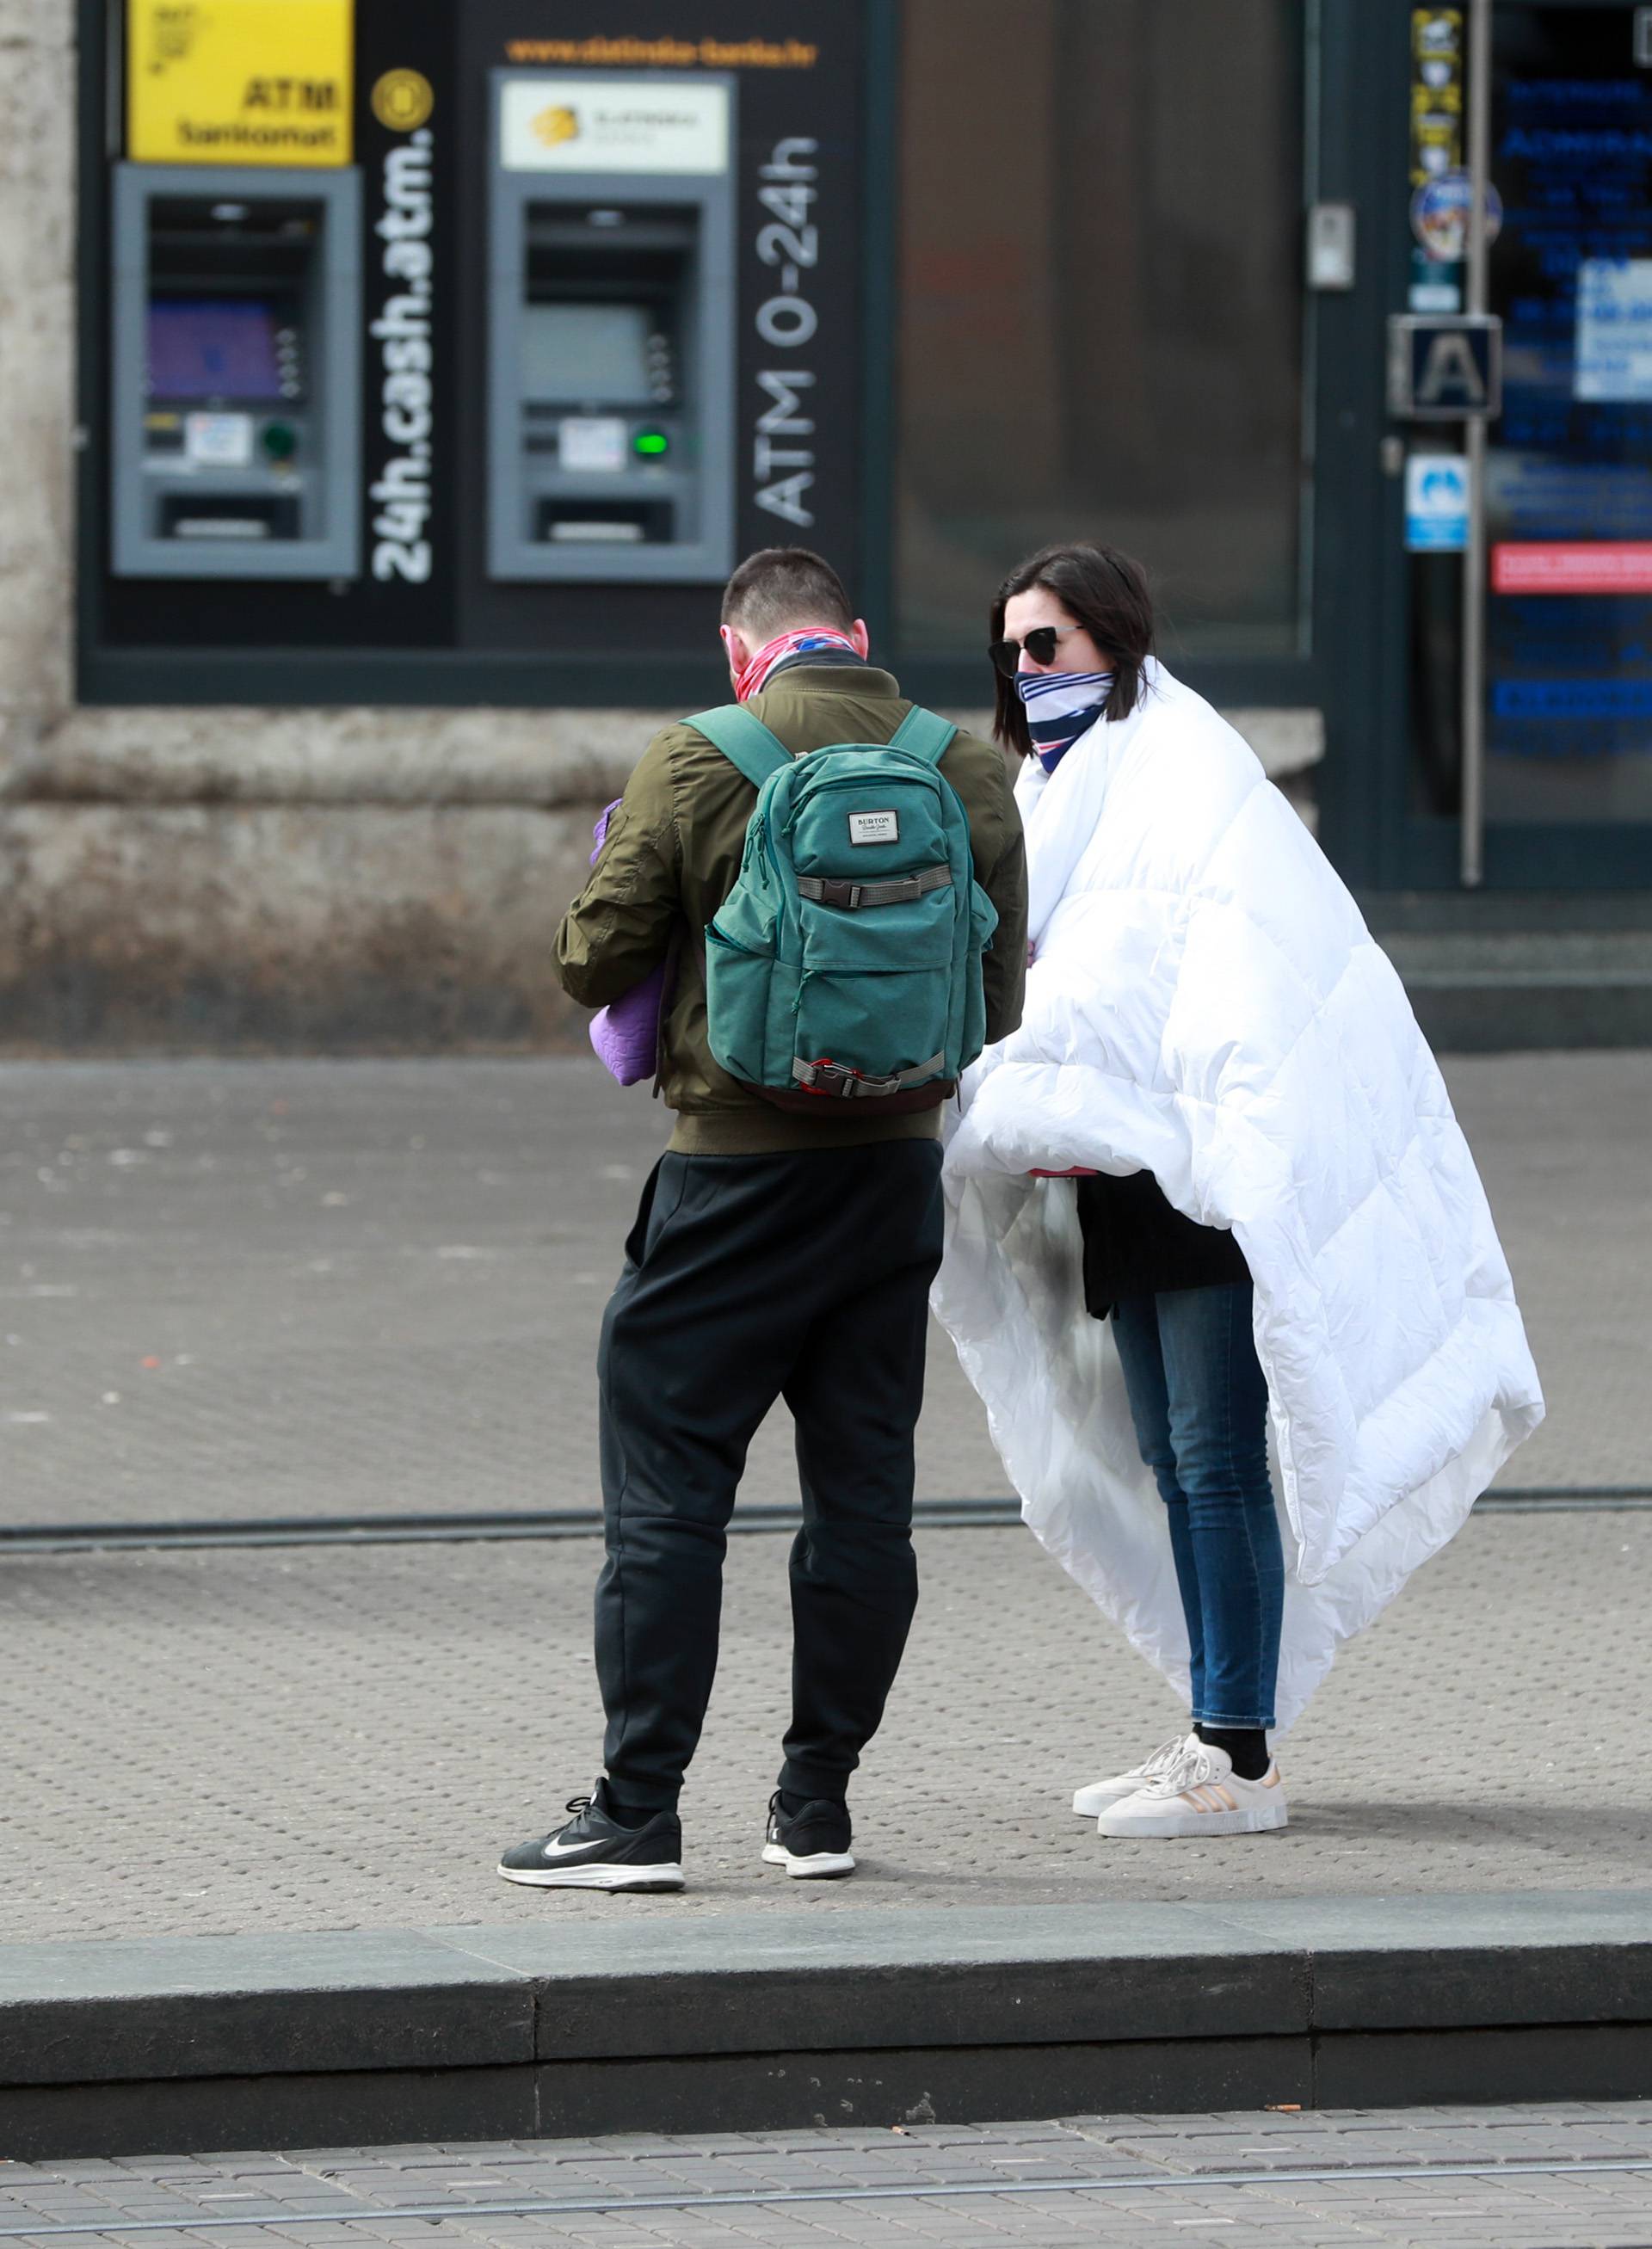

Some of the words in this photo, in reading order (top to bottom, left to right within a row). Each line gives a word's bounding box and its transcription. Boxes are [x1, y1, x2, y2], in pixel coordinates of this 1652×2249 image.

[242, 78, 339, 112] ATM
[177, 120, 336, 147] bankomat
[755, 137, 819, 348] 0-24h
[370, 127, 432, 584] 24h.cash.atm.
[1417, 332, 1486, 403] A
[754, 370, 816, 527] ATM
[858, 816, 890, 826] BURTON
